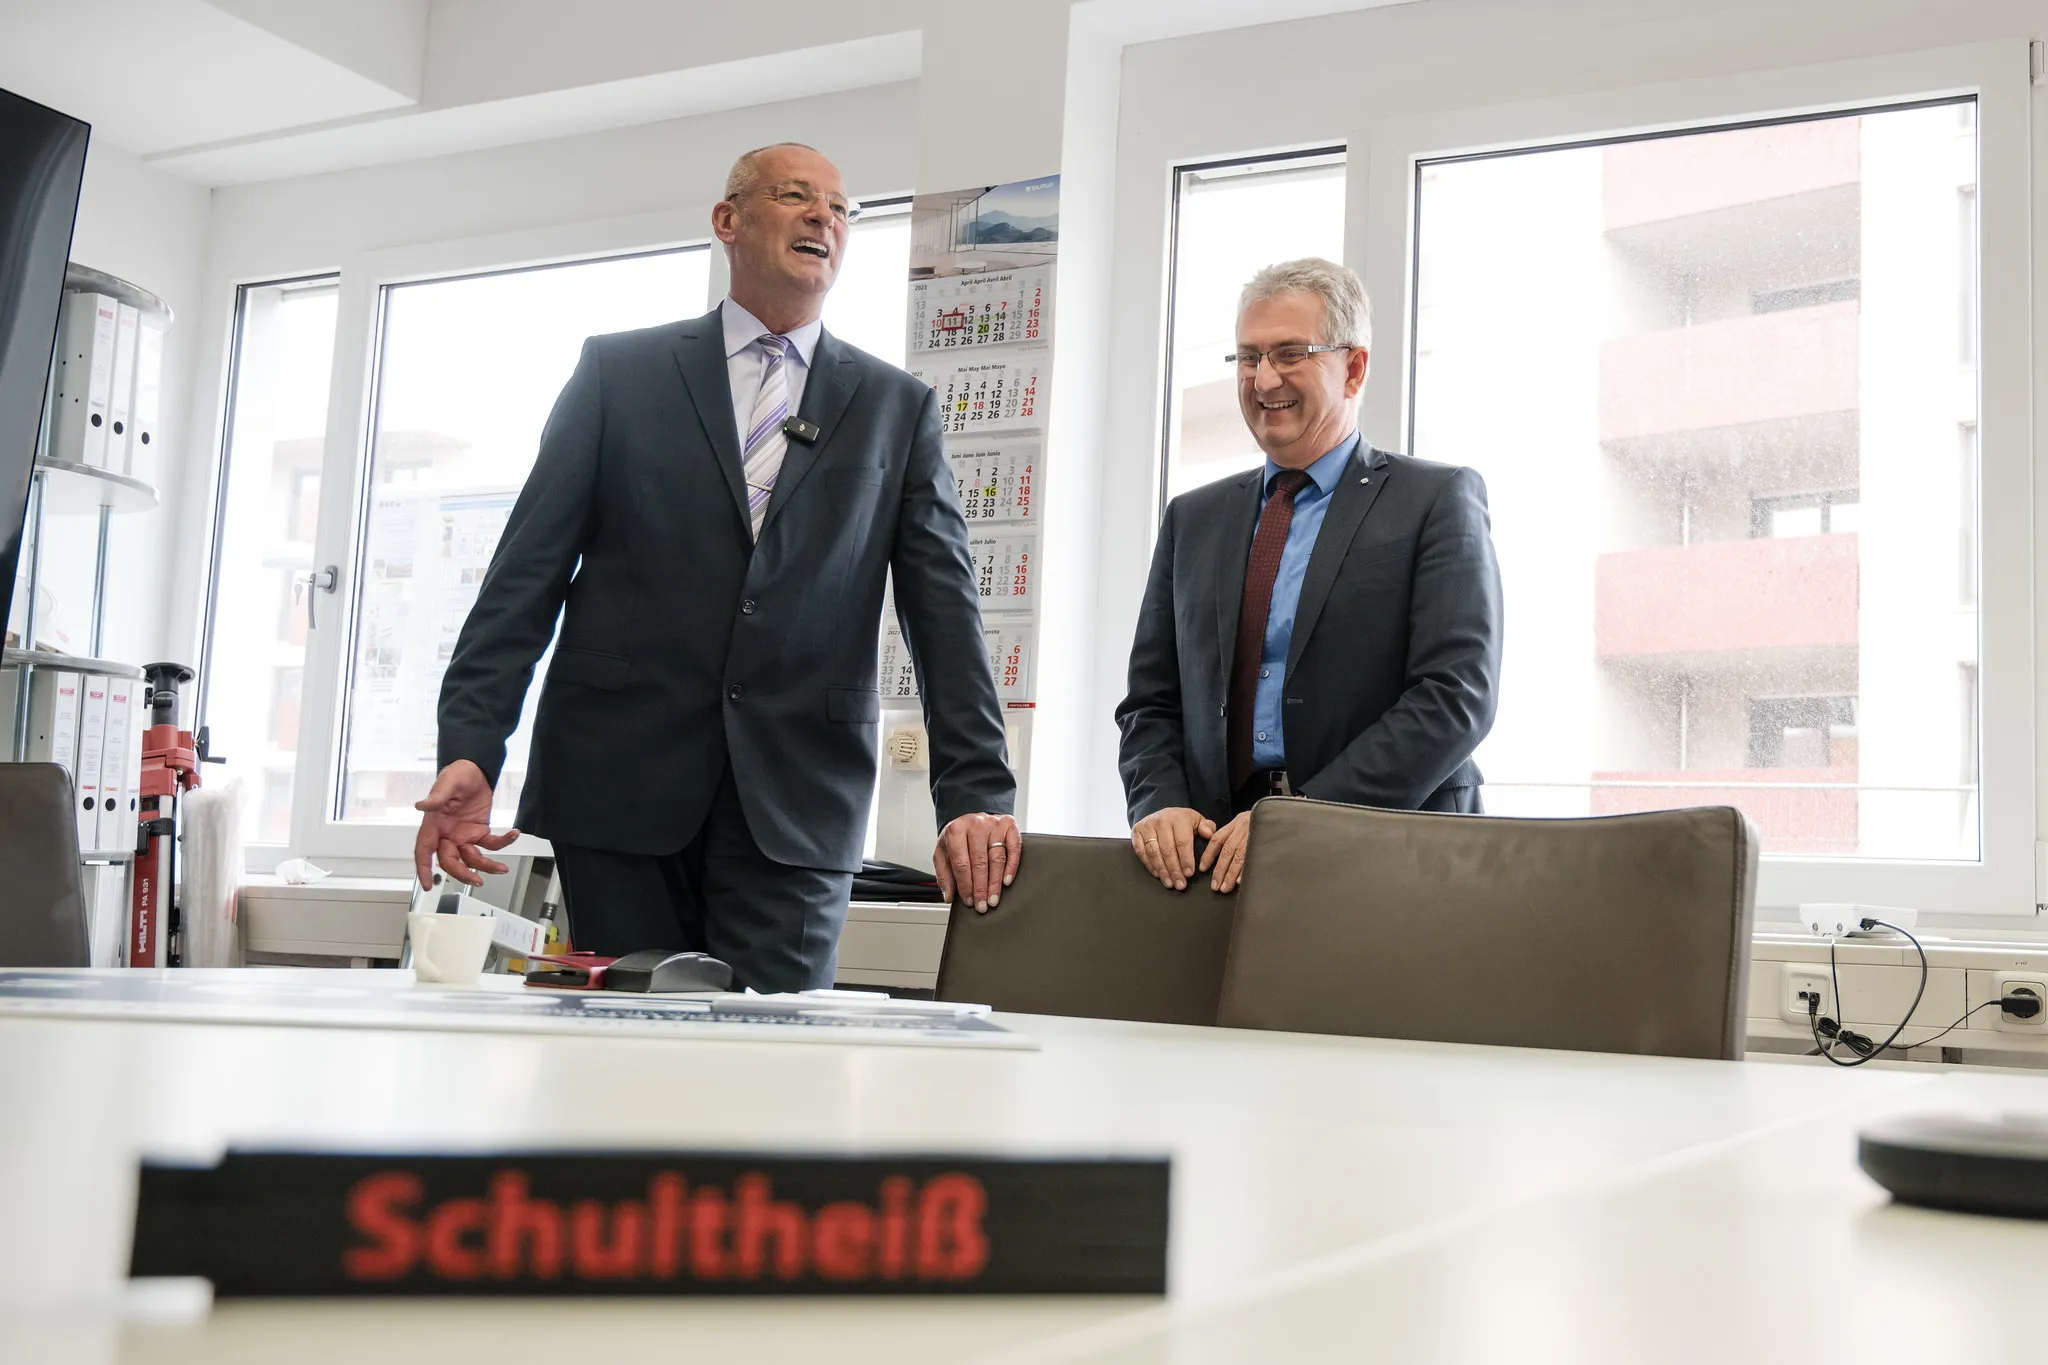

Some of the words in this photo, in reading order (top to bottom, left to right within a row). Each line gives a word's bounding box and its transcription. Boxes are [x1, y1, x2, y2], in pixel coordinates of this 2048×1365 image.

[1020, 290, 1024, 298] 1
[1035, 288, 1041, 296] 2
[916, 301, 926, 310] 13
[937, 309, 942, 317] 3
[969, 306, 974, 314] 5
[985, 304, 991, 312] 6
[1001, 302, 1007, 310] 7
[1018, 300, 1023, 308] 8
[1035, 298, 1040, 307] 9
[932, 319, 941, 328] 10
[964, 316, 974, 324] 12
[980, 314, 990, 323] 13
[996, 312, 1006, 321] 14
[1012, 311, 1022, 319] 15
[1028, 309, 1039, 317] 16
[931, 330, 941, 338] 17
[963, 326, 973, 334] 19
[978, 324, 989, 334] 20
[994, 322, 1004, 331] 21
[1010, 321, 1021, 330] 22
[1027, 319, 1039, 328] 23
[929, 340, 940, 348] 24
[945, 338, 956, 346] 25
[961, 336, 972, 345] 26
[977, 335, 988, 344] 27
[993, 332, 1004, 341] 28
[1009, 331, 1021, 340] 29
[1026, 330, 1038, 338] 30
[948, 384, 953, 392] 2
[964, 382, 970, 391] 3
[980, 381, 987, 390] 4
[997, 380, 1003, 388] 5
[1014, 378, 1020, 386] 6
[1031, 376, 1037, 385] 7
[947, 394, 953, 402] 9
[958, 393, 969, 401] 10
[975, 391, 985, 400] 11
[991, 390, 1002, 399] 12
[1007, 388, 1019, 397] 13
[1024, 387, 1036, 396] 14
[941, 404, 951, 412] 16
[957, 402, 968, 411] 17
[973, 401, 984, 410] 18
[990, 400, 1001, 409] 19
[1005, 399, 1018, 407] 20
[1022, 397, 1034, 406] 21
[954, 413, 966, 422] 24
[971, 412, 983, 420] 25
[988, 410, 999, 419] 26
[1004, 409, 1016, 418] 27
[1020, 408, 1033, 416] 28
[953, 423, 964, 432] 31
[976, 468, 981, 476] 1
[992, 467, 998, 476] 2
[1009, 466, 1015, 475] 3
[1026, 465, 1032, 474] 4
[958, 480, 964, 488] 7
[974, 479, 980, 488] 8
[991, 478, 997, 487] 9
[1003, 476, 1014, 485] 10
[1020, 476, 1031, 484] 11
[968, 489, 979, 497] 15
[985, 488, 996, 496] 16
[1002, 487, 1013, 496] 17
[1019, 486, 1030, 495] 18
[966, 500, 978, 508] 22
[983, 499, 995, 507] 23
[1000, 498, 1012, 506] 24
[1017, 497, 1030, 506] 25
[965, 510, 977, 518] 29
[982, 509, 994, 518] 30
[1006, 508, 1010, 516] 1
[1023, 507, 1029, 516] 2
[988, 556, 994, 564] 7
[1005, 555, 1010, 564] 8
[1022, 554, 1028, 563] 9
[982, 567, 992, 575] 14
[1000, 566, 1010, 574] 15
[1016, 565, 1026, 574] 16
[980, 577, 991, 585] 21
[997, 577, 1009, 585] 22
[1014, 576, 1026, 584] 23
[980, 588, 991, 596] 28
[996, 587, 1008, 595] 29
[1013, 586, 1025, 595] 30
[884, 645, 896, 654] 31
[1014, 645, 1020, 653] 6
[883, 656, 895, 664] 32
[1007, 656, 1019, 664] 13
[882, 666, 893, 675] 33
[901, 666, 912, 674] 14
[1005, 666, 1018, 675] 20
[880, 677, 892, 685] 34
[1004, 677, 1016, 686] 27
[880, 687, 891, 695] 35
[898, 687, 910, 695] 28
[142, 895, 148, 906] PA
[139, 910, 147, 953] HILTI
[341, 1171, 988, 1282] Schultheiß
